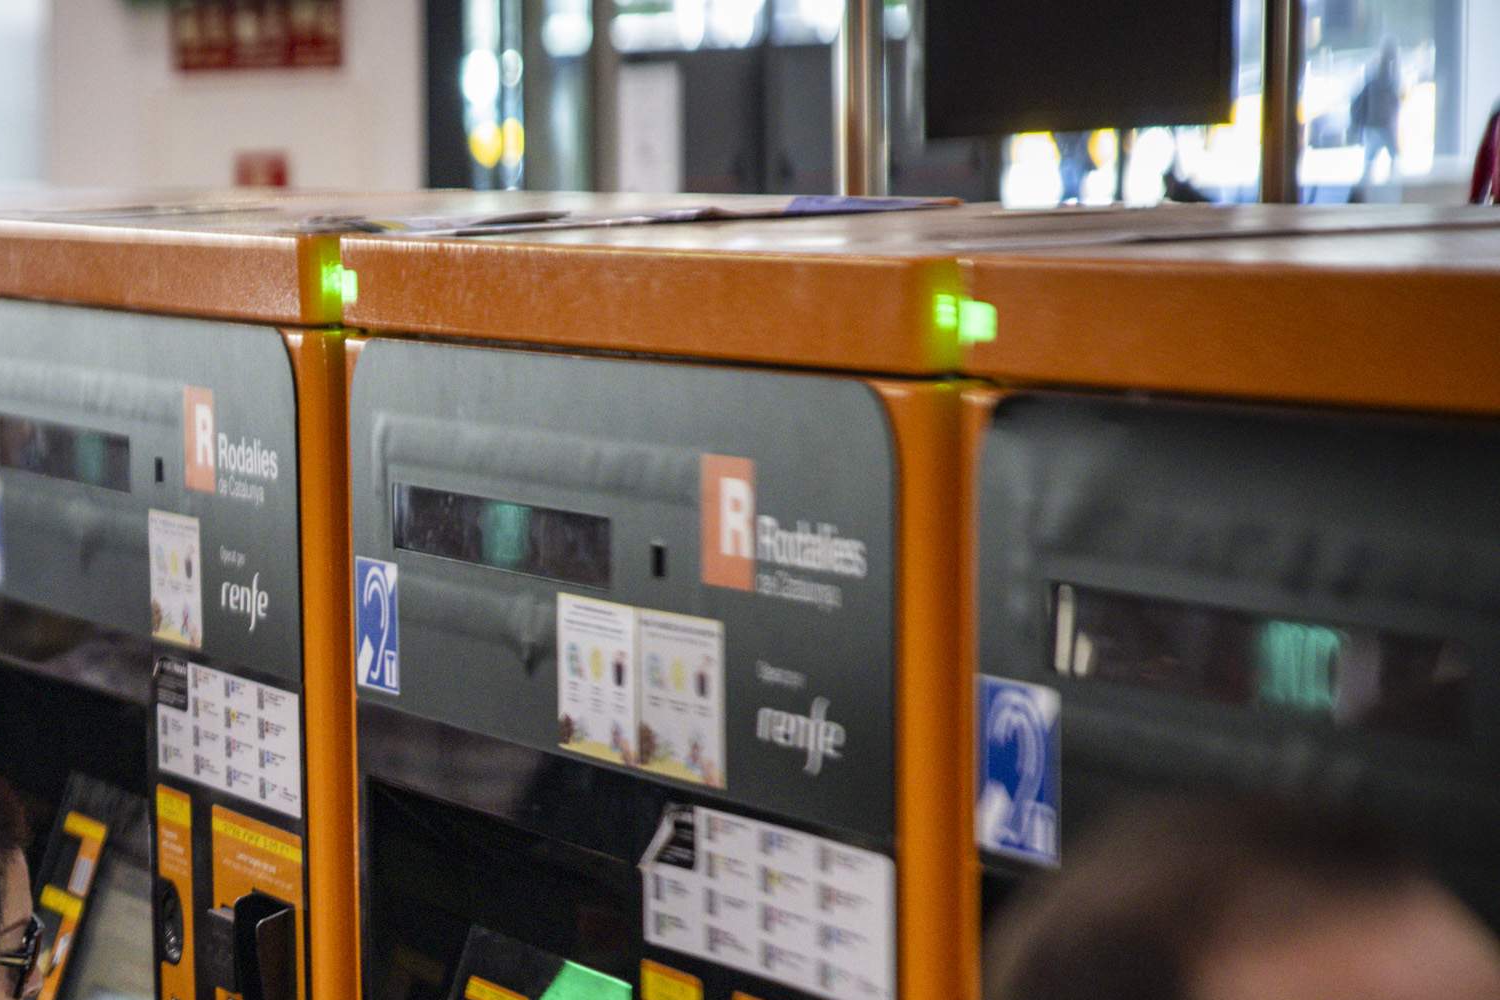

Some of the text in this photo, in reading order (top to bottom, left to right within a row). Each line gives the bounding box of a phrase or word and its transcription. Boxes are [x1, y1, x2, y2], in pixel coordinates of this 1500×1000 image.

[195, 404, 213, 468] R
[218, 432, 278, 481] Rodalies
[720, 477, 755, 560] R
[221, 572, 268, 630] renfe
